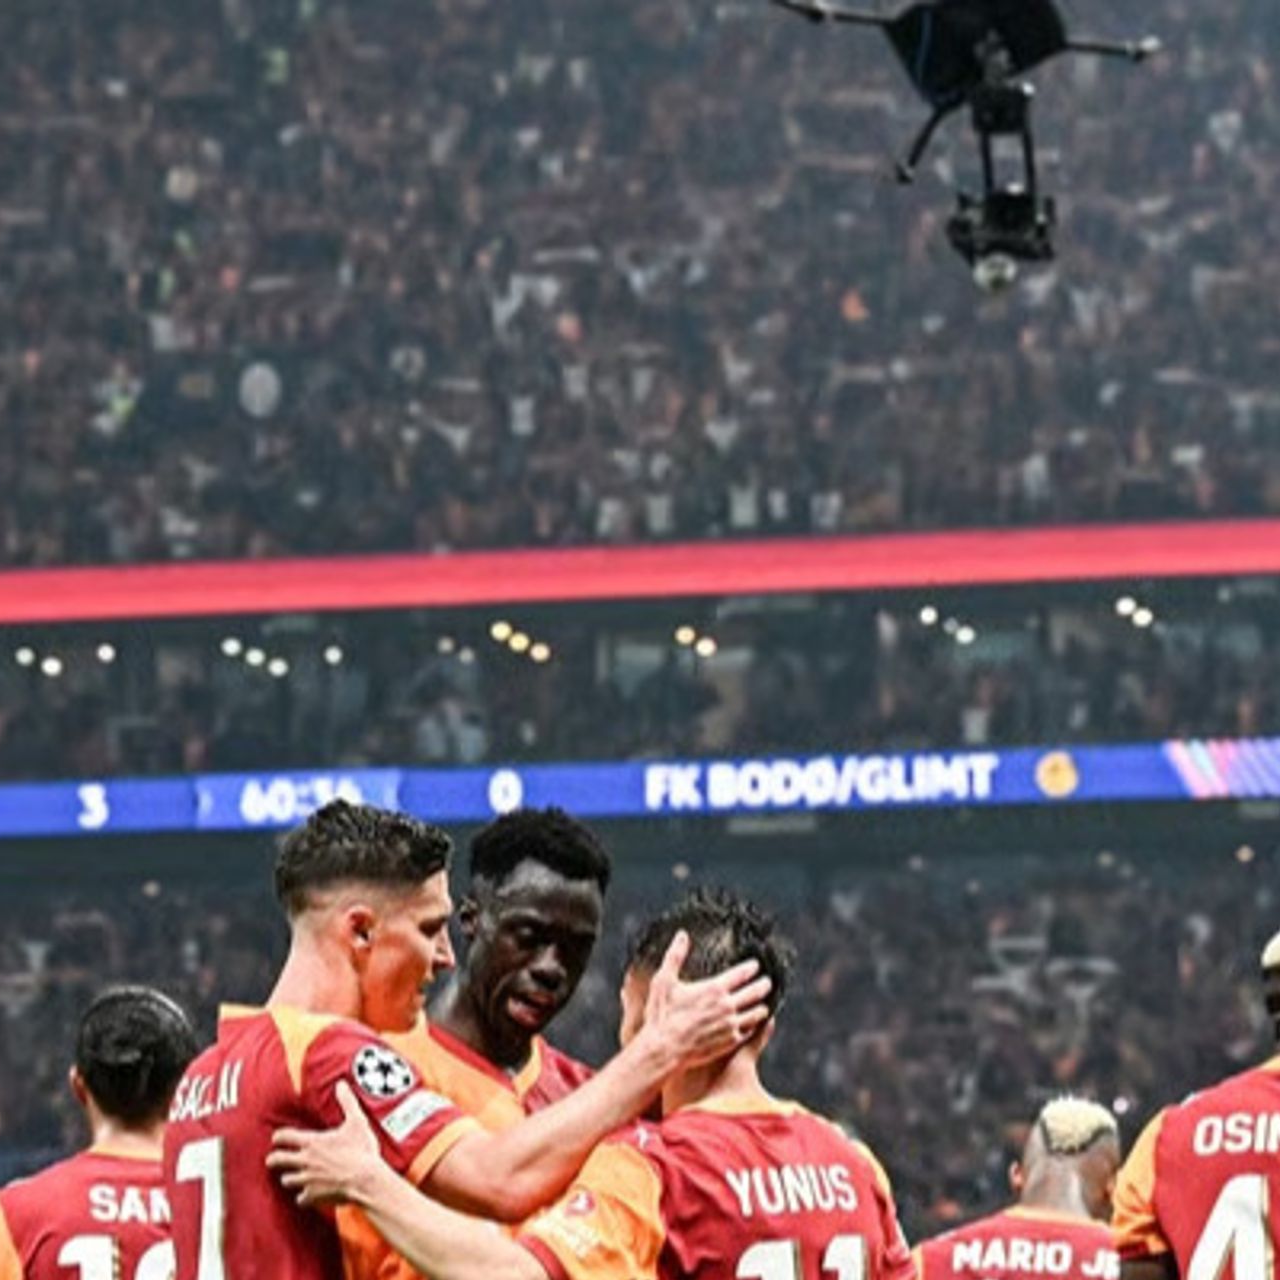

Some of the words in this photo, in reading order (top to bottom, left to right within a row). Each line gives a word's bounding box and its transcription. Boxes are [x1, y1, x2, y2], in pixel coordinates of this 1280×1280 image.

[76, 783, 110, 829] 3
[645, 763, 702, 809] FK
[727, 1163, 858, 1217] YUNUS
[952, 1237, 1072, 1275] MARIO
